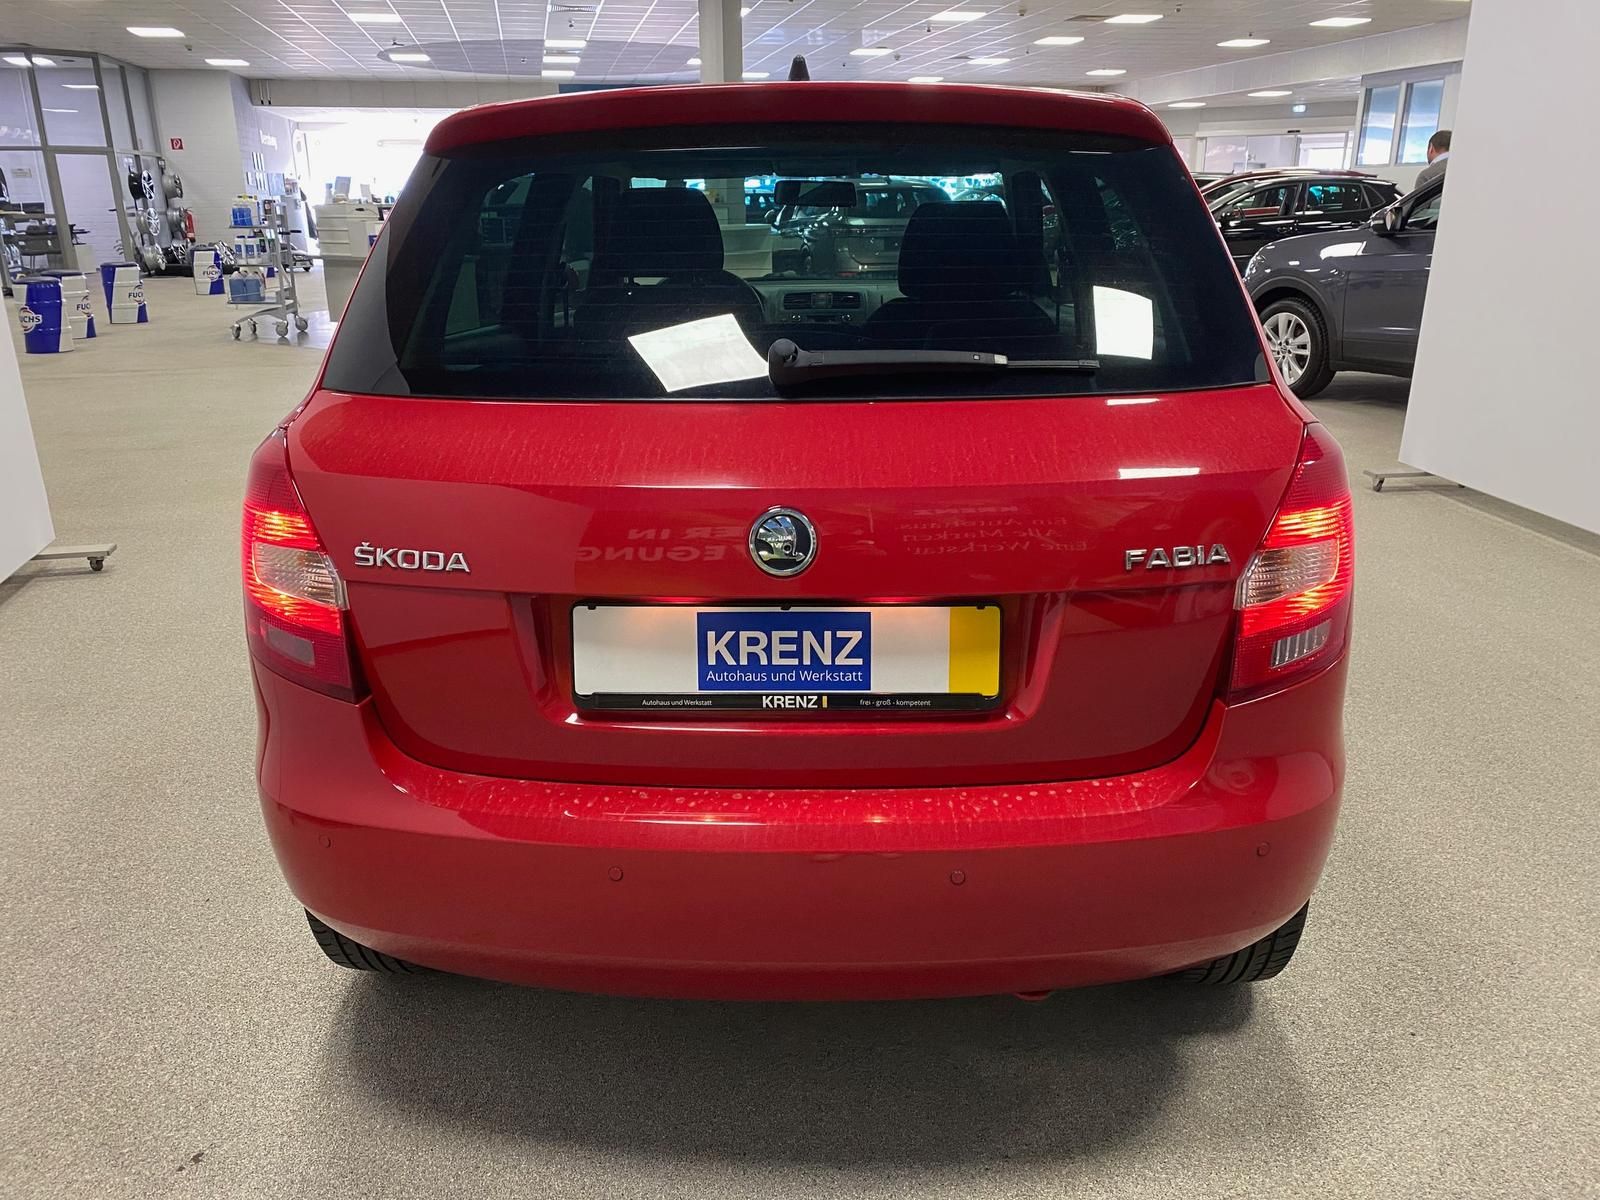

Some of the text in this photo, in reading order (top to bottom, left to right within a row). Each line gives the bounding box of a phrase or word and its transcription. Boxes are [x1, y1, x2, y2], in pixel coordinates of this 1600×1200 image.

[353, 542, 470, 573] ŠKODA
[1125, 543, 1231, 571] FABIA
[707, 630, 864, 666] KRENZ
[706, 670, 863, 682] Autohaus und Werkstatt
[762, 695, 818, 708] KRENZ
[896, 699, 931, 707] kompetent
